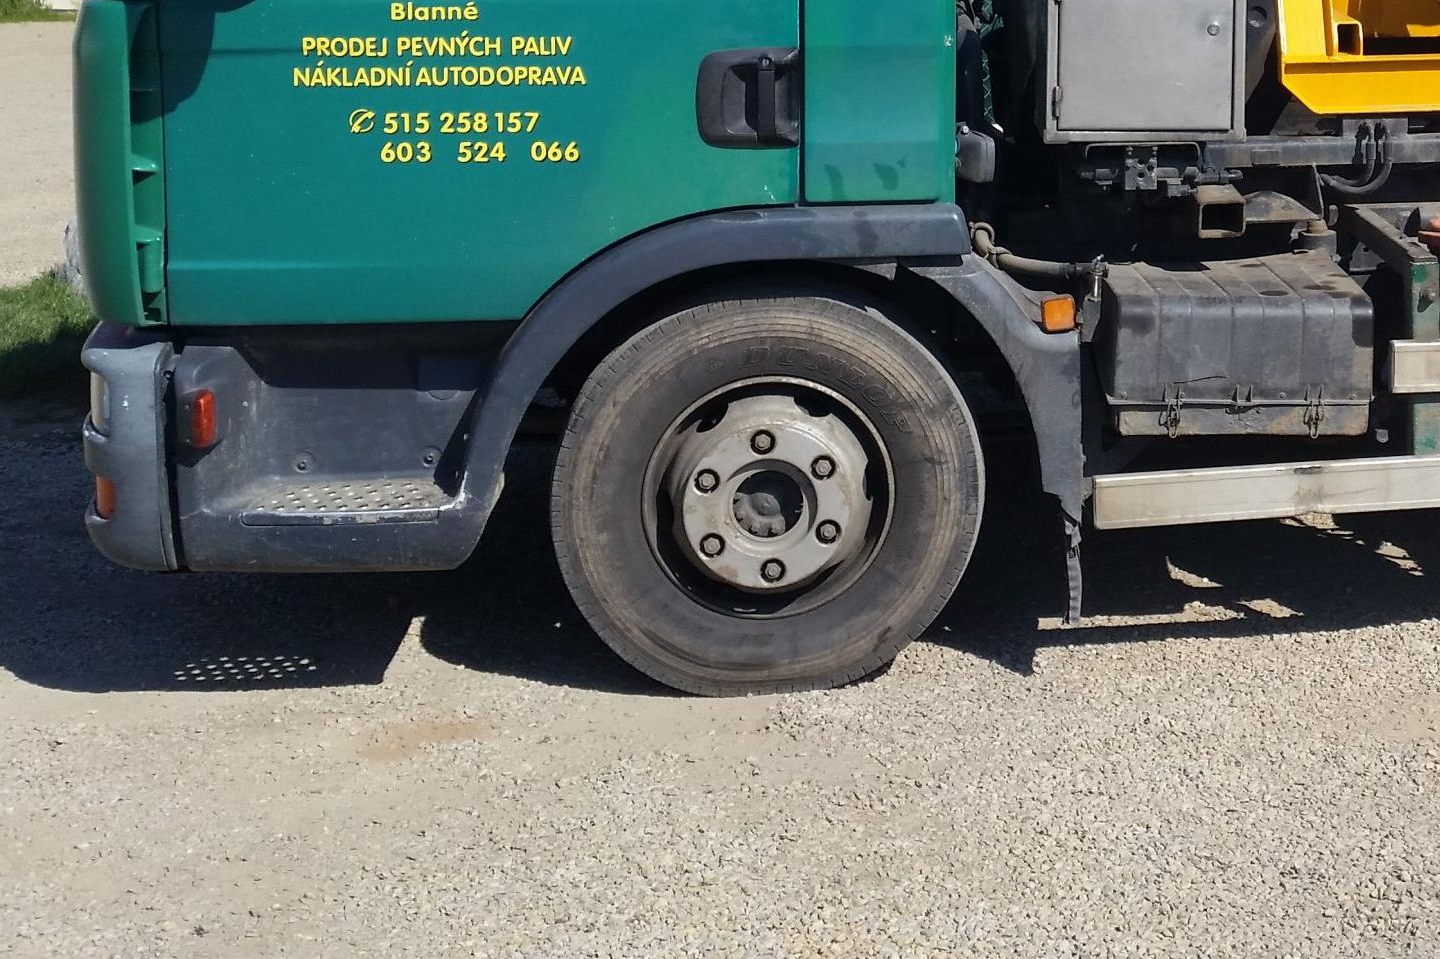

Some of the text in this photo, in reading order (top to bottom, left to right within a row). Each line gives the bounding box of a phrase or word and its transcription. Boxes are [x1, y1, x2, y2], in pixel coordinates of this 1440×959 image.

[390, 1, 480, 22] Blanné
[302, 30, 572, 58] PRODEJ PEVNÝCH PALIV
[293, 59, 587, 88] NÁKLADNÍ AUTODOPRAVA
[383, 111, 540, 134] 515 258 157
[380, 141, 579, 163] 603 524 066
